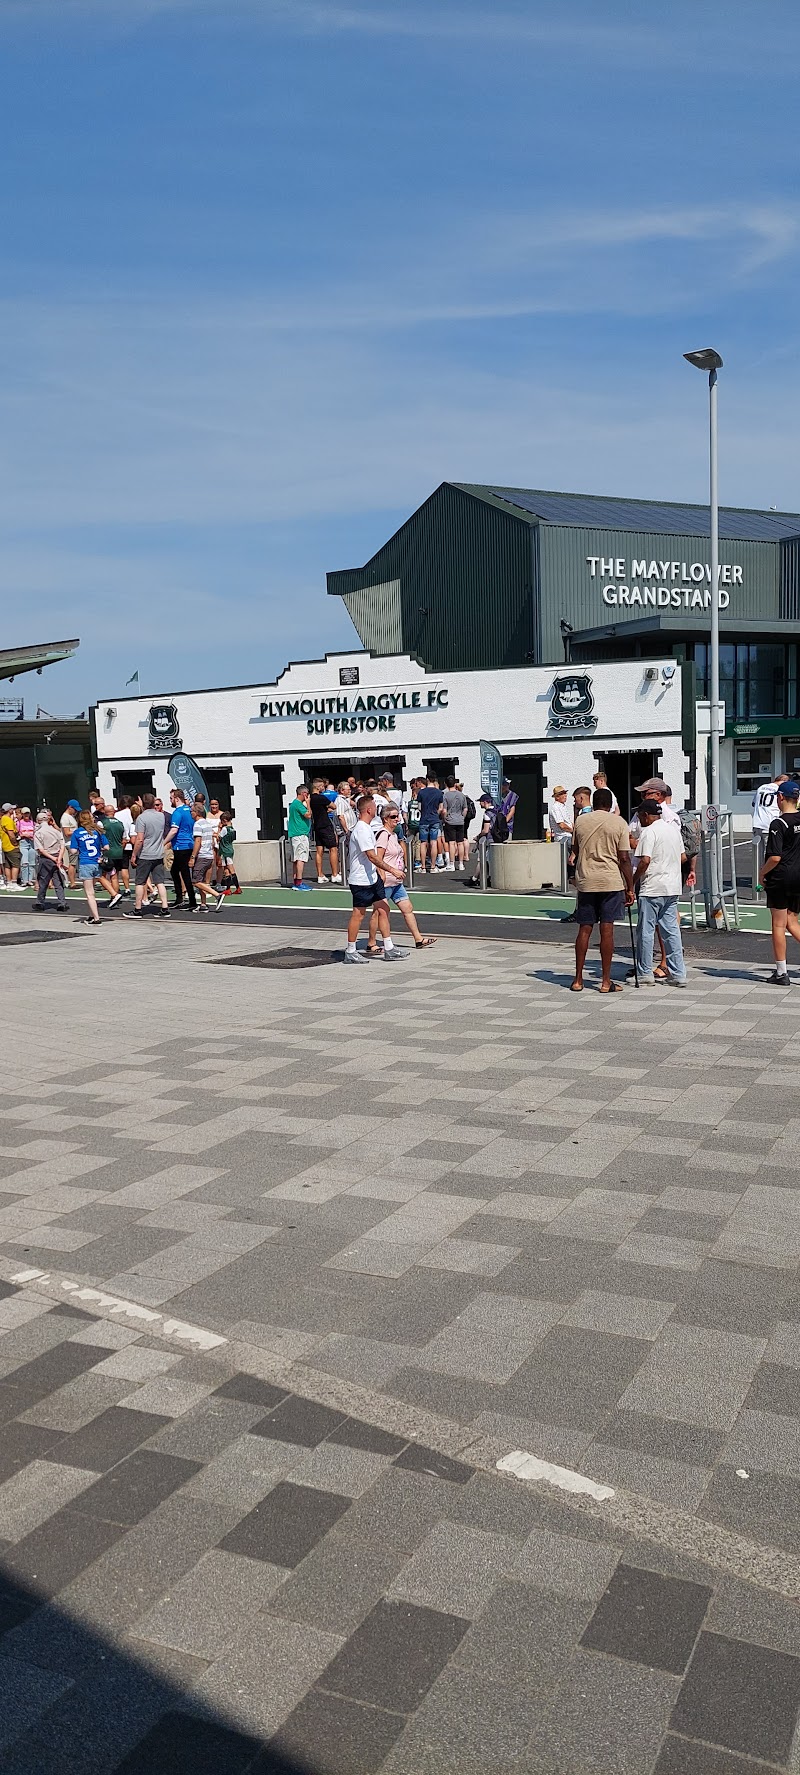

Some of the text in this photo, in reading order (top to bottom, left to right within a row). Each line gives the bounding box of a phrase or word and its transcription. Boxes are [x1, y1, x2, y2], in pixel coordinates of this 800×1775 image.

[586, 556, 744, 584] THE MAYFLOWER
[602, 584, 730, 608] GRANDSTAND
[259, 689, 449, 718] PLYMOUTH ARGYLE FC
[306, 715, 396, 735] SUPERSTORE
[759, 791, 775, 808] 10
[409, 808, 422, 822] 10
[85, 839, 98, 857] 5
